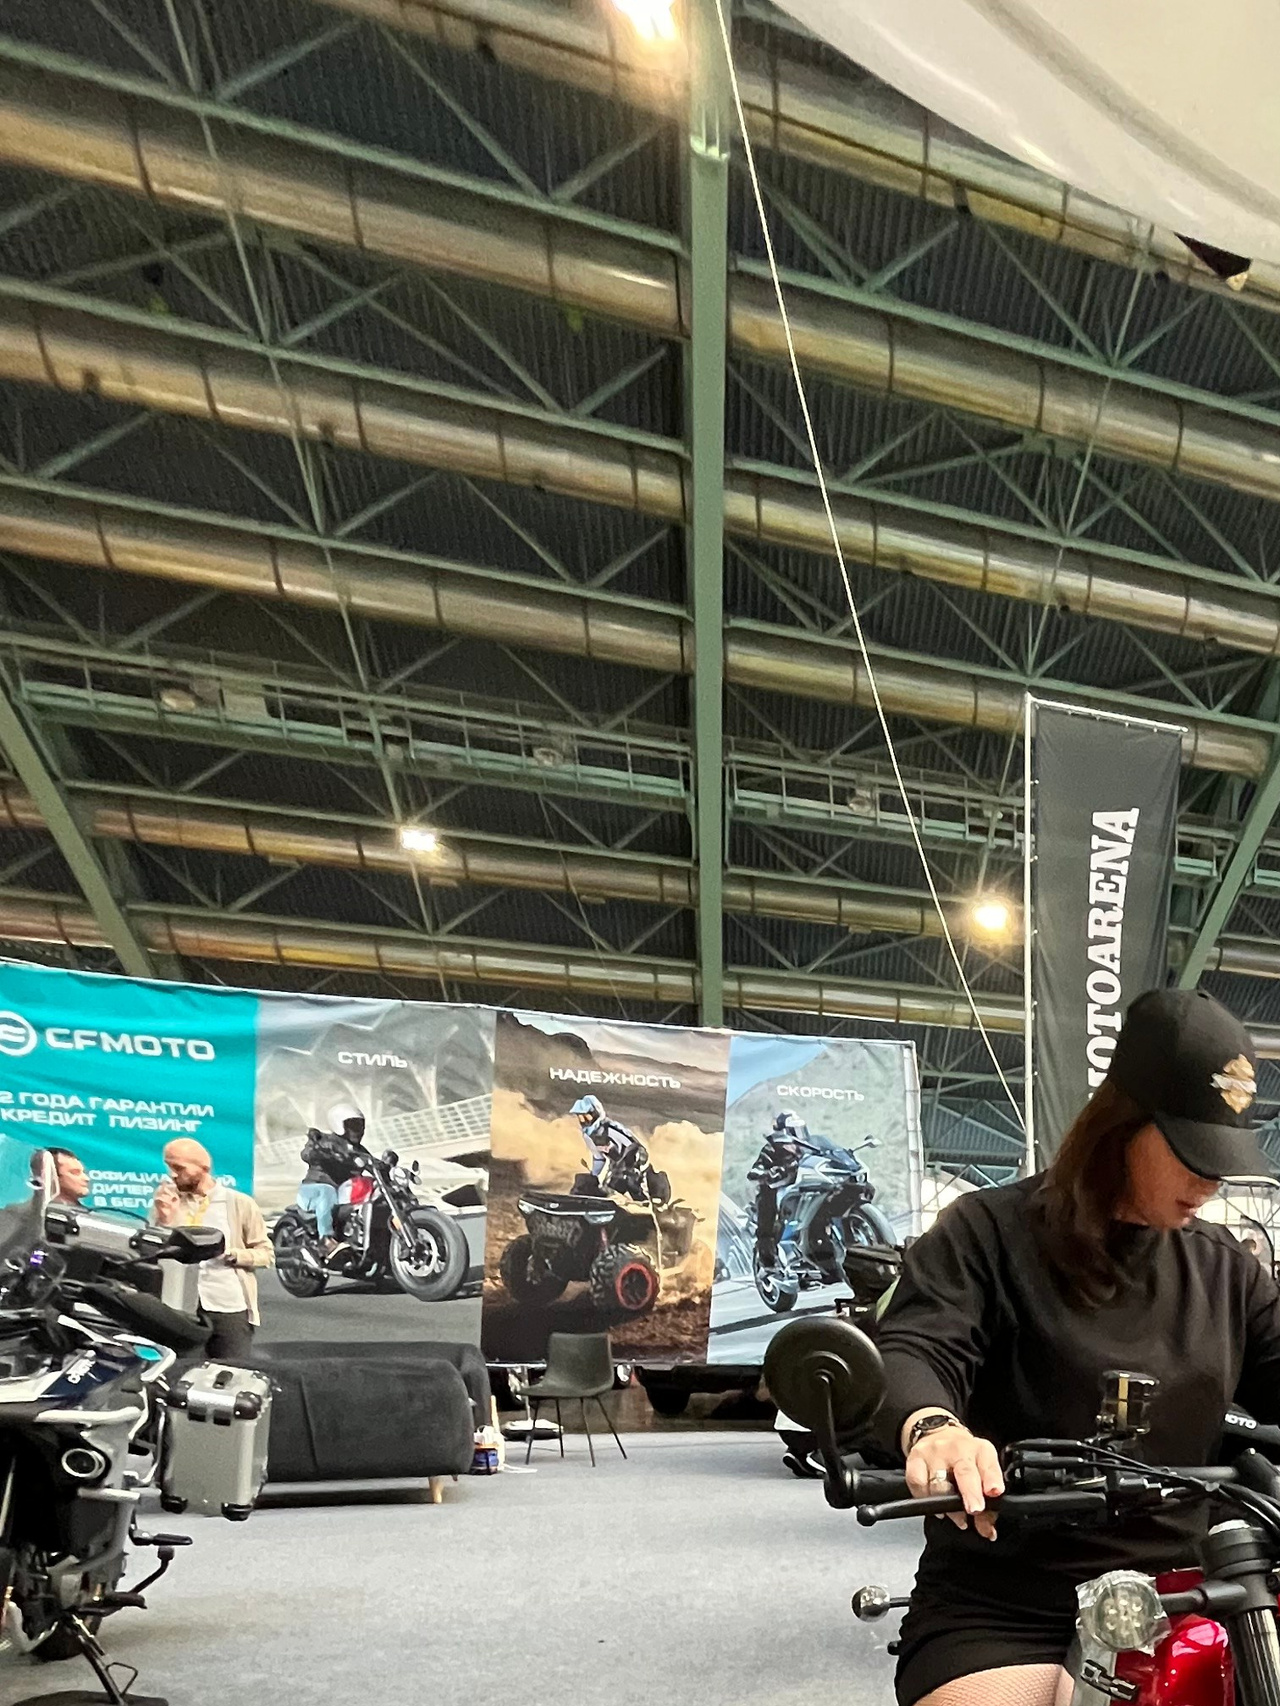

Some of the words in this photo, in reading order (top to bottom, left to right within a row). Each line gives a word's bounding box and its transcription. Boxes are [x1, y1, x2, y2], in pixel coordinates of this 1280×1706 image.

[45, 1027, 216, 1061] CFMOTO
[337, 1051, 408, 1068] СТИЛЬ
[549, 1066, 681, 1089] НАДЕЖНОСТЬ
[776, 1084, 865, 1101] СКОРОСТЬ
[0, 1090, 14, 1104] 2
[18, 1092, 86, 1110] ГОДА
[88, 1096, 215, 1118] ГАРАНТИИ
[0, 1108, 97, 1127] КРЕДИТ
[108, 1114, 203, 1132] ЛИЗИНГ
[94, 1195, 108, 1207] В
[1225, 1413, 1257, 1430] OTO
